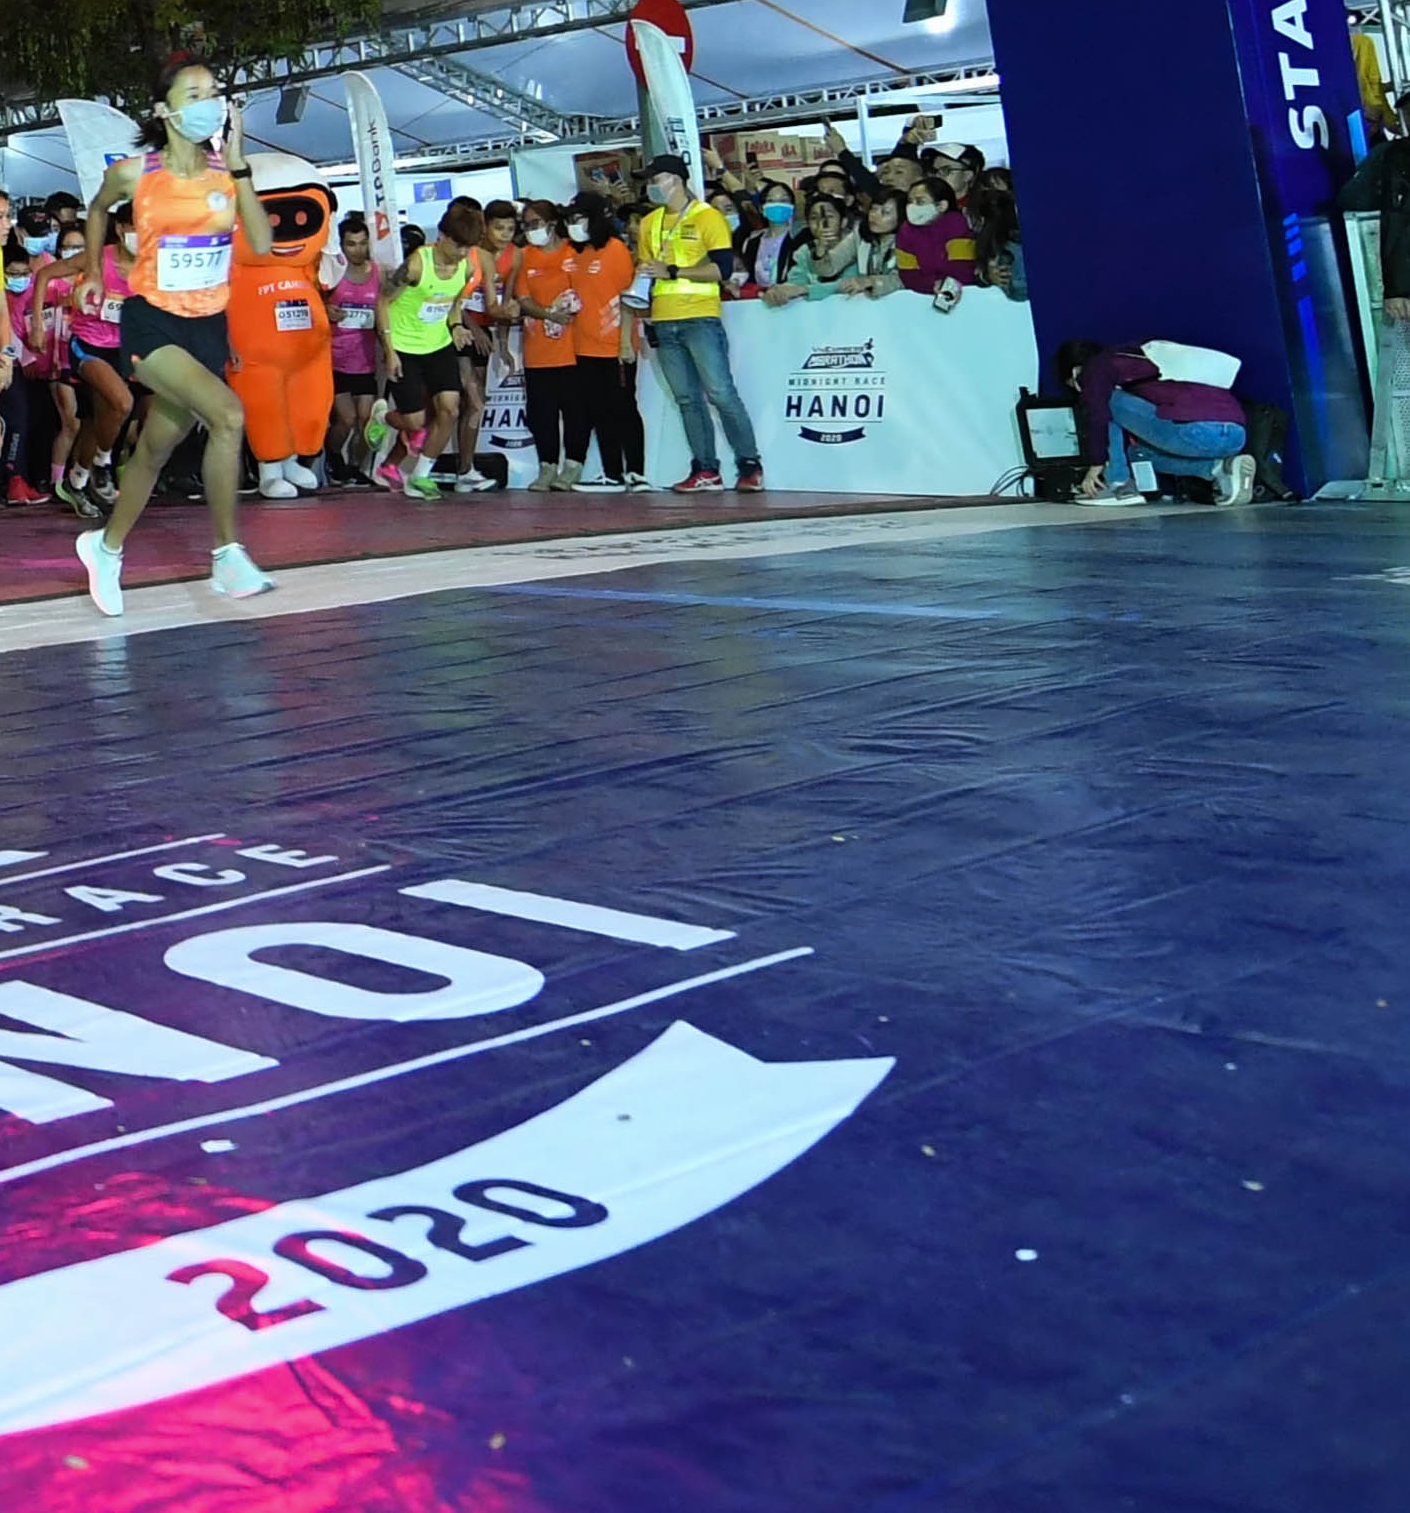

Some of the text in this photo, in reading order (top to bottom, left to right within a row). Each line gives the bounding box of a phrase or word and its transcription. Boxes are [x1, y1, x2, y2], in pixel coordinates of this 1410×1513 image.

[169, 250, 222, 269] 59577
[788, 377, 847, 386] MIDNIGHT
[785, 394, 884, 418] HANOI
[481, 409, 528, 428] HAN
[163, 1178, 610, 1332] 2020
